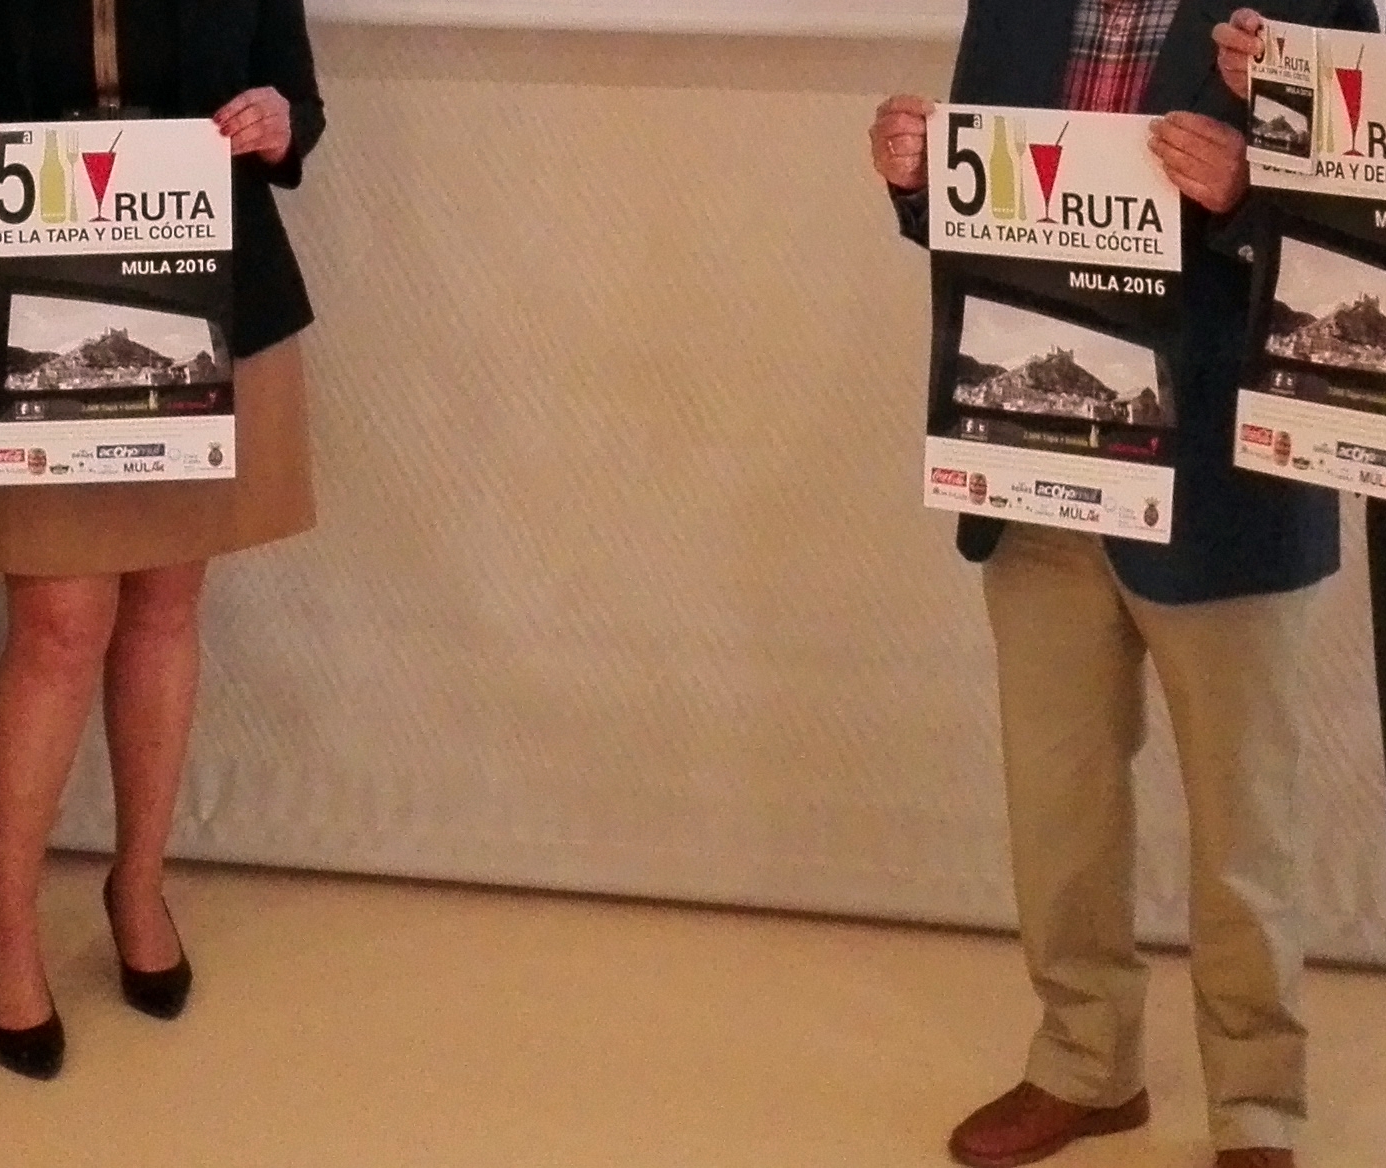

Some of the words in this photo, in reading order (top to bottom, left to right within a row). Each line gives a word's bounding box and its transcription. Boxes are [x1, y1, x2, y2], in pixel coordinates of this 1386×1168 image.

[1315, 160, 1345, 180] APA
[1349, 163, 1360, 181] Y
[114, 190, 215, 223] RUTA
[1061, 192, 1164, 234] RUTA
[18, 228, 41, 245] LA
[46, 227, 90, 243] TAPA
[94, 227, 106, 242] Y
[111, 226, 144, 241] DEL
[149, 221, 216, 240] CÓCTEL
[945, 221, 965, 239] DE
[970, 222, 992, 241] LA
[996, 225, 1039, 245] TAPA
[1042, 229, 1054, 246] Y
[1058, 231, 1091, 249] DEL
[1095, 231, 1164, 256] CÓCTEL
[121, 259, 172, 276] MULA
[175, 258, 217, 274] 2016
[1069, 270, 1120, 292] MULA
[1123, 276, 1166, 297] 2016
